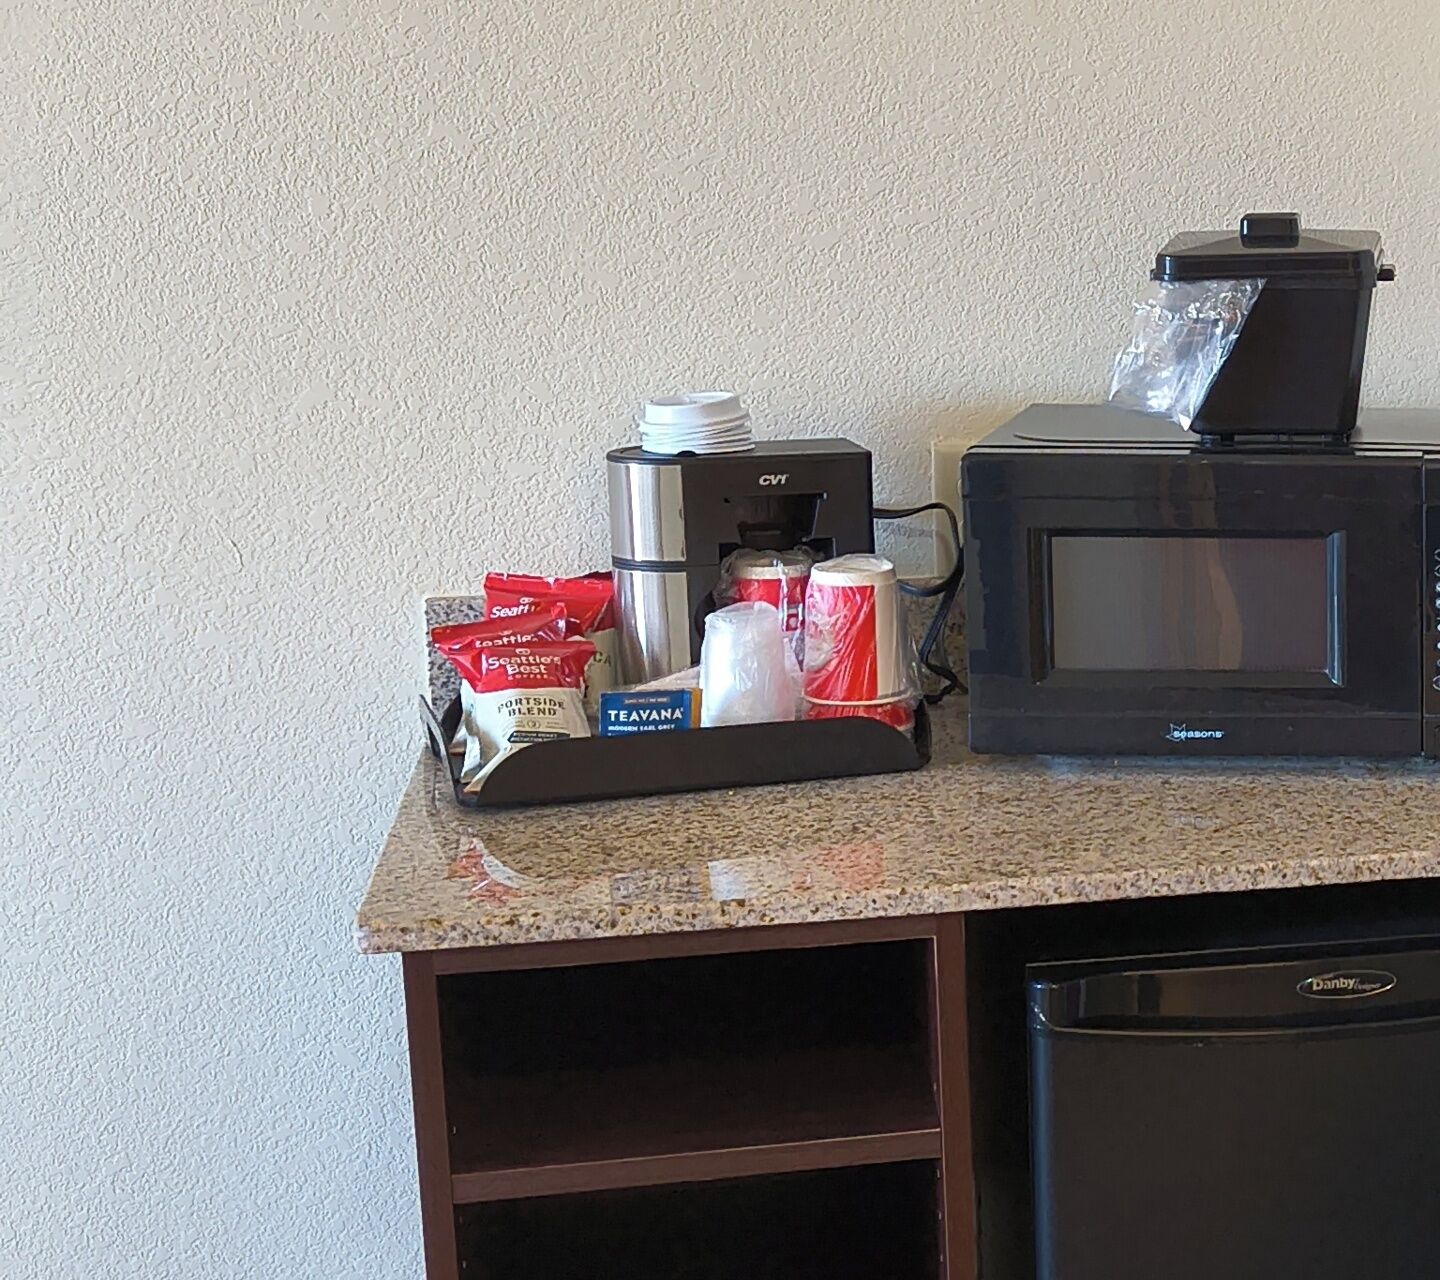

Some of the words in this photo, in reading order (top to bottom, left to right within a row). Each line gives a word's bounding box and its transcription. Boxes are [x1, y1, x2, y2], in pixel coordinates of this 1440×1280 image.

[488, 655, 561, 670] Seattle's
[506, 663, 548, 675] Best
[497, 696, 566, 714] PORTSIDE
[508, 706, 557, 717] BLEND
[607, 708, 683, 722] TEAVANA
[1312, 978, 1355, 991] Danby
